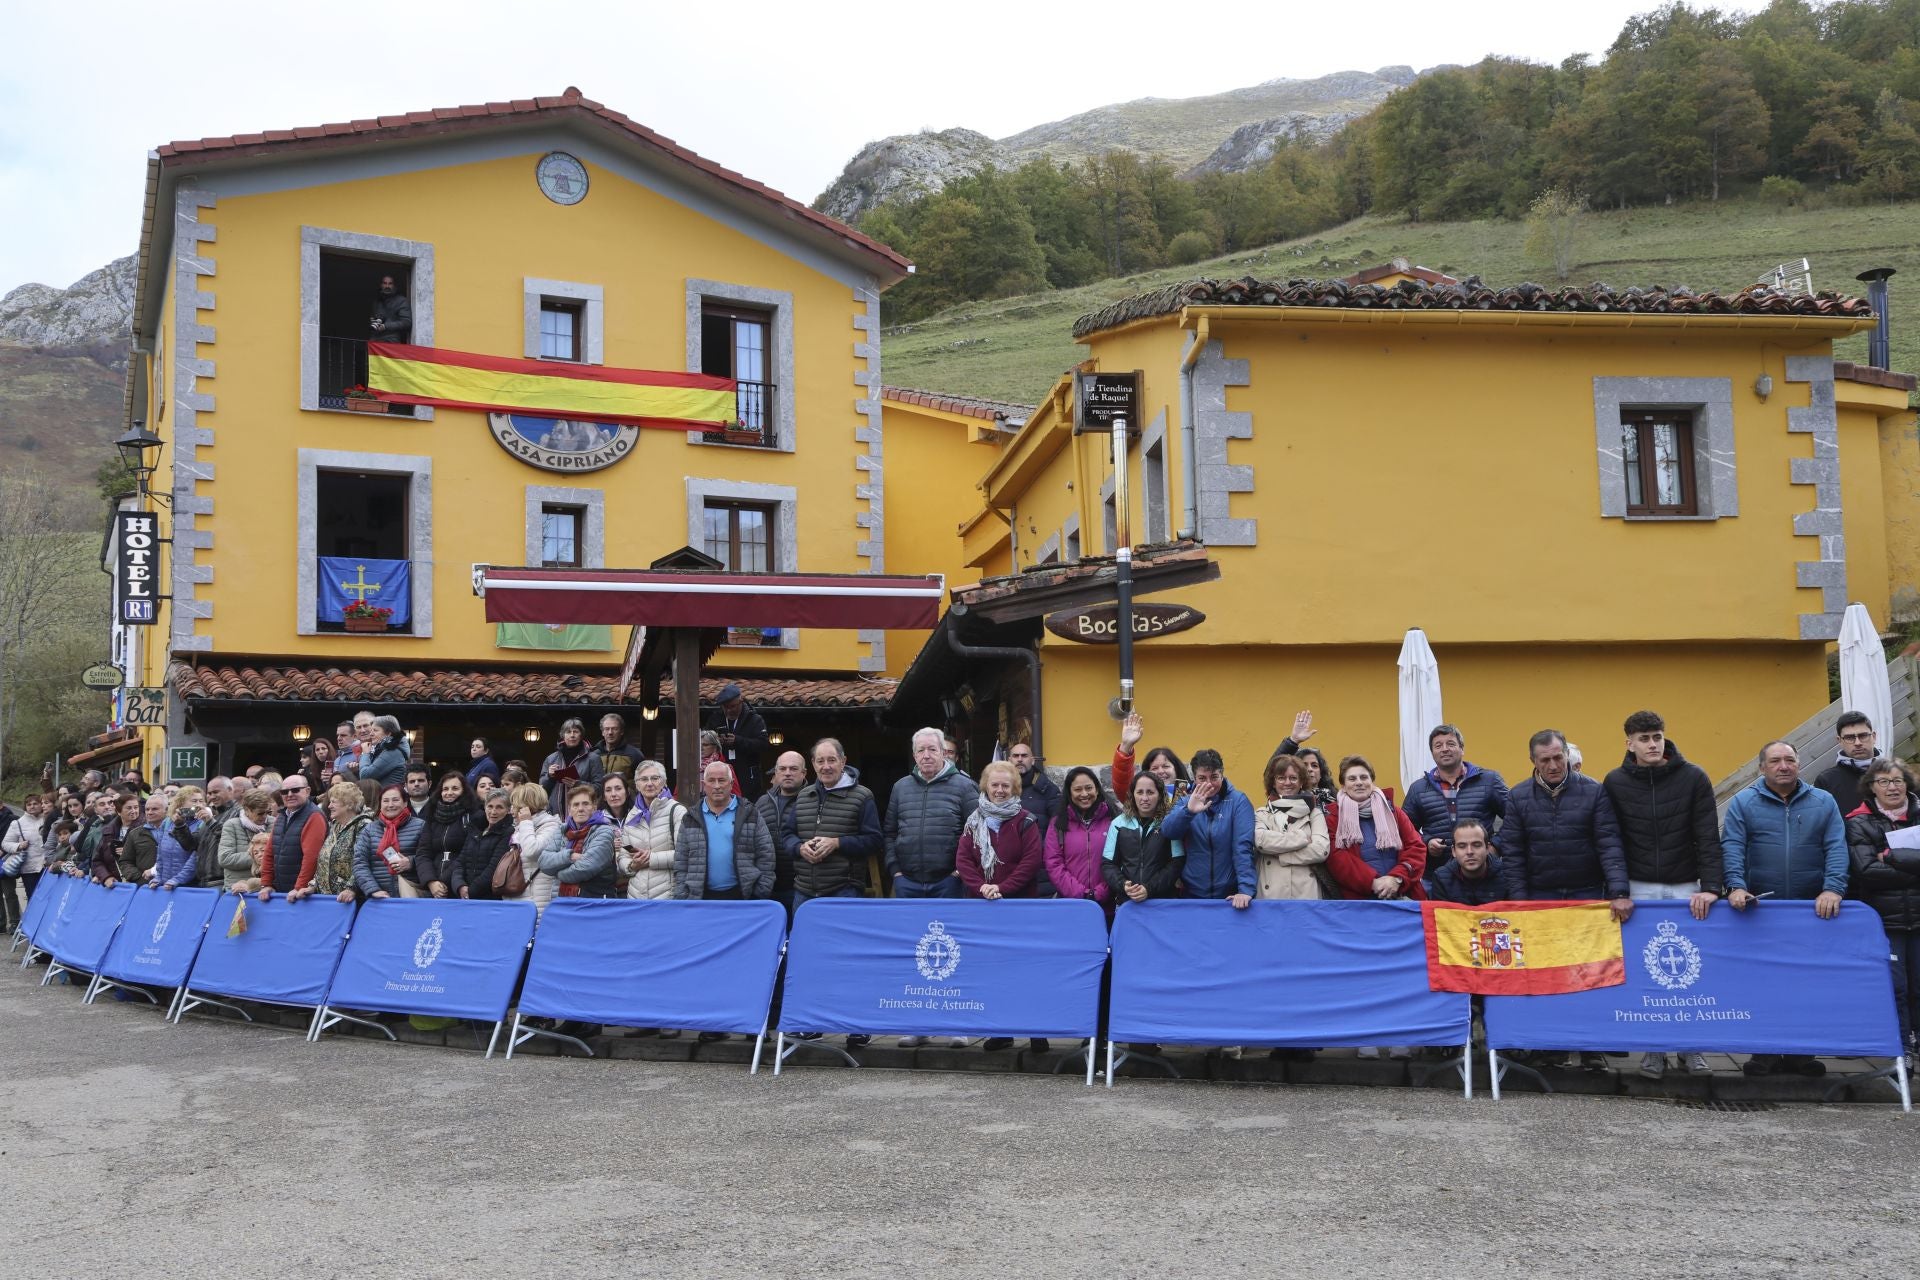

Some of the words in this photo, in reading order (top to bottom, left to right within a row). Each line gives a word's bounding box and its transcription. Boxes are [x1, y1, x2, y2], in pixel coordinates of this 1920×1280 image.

[1085, 384, 1095, 392] La
[1097, 384, 1133, 393] Tiendina
[1101, 394, 1129, 403] Raquel
[500, 429, 541, 463] CASA
[546, 440, 628, 468] CIPRIANO
[125, 517, 152, 597] HOTEL
[1078, 612, 1163, 635] Boctas
[125, 695, 165, 724] Bar
[402, 971, 435, 982] Fundación
[384, 981, 409, 992] Princesa
[410, 983, 418, 992] de
[419, 984, 445, 994] Asturias
[903, 984, 961, 997] Fundación
[878, 998, 923, 1009] Princesa
[925, 999, 939, 1009] de
[940, 1000, 985, 1011] Asturias
[1642, 994, 1716, 1007] Fundación
[1615, 1010, 1671, 1022] Princesa
[1674, 1010, 1692, 1022] de
[1695, 1009, 1751, 1021] Asturias
